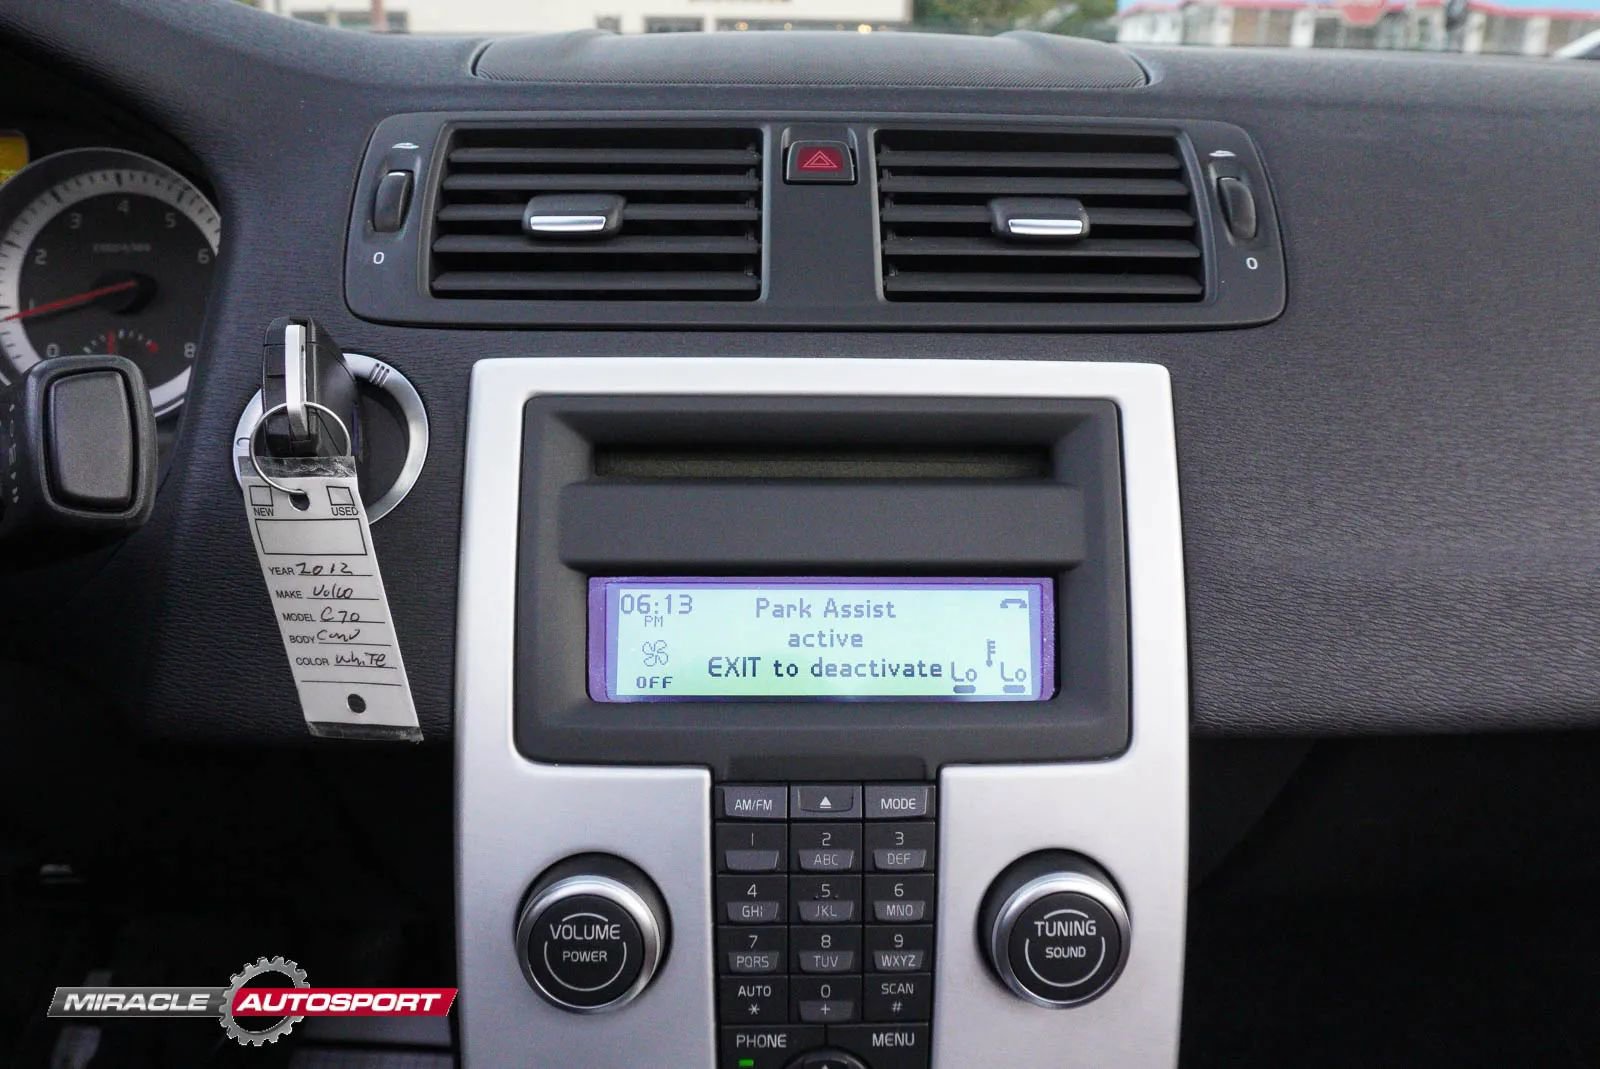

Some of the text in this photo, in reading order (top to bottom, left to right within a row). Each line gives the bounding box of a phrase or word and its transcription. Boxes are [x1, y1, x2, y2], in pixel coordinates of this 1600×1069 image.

[117, 200, 129, 214] 4
[70, 213, 82, 229] 3
[165, 212, 176, 228] 5
[34, 250, 47, 265] 2
[197, 250, 209, 264] 6
[47, 343, 59, 358] 0
[184, 342, 196, 357] 8
[253, 507, 274, 517] NEW
[331, 507, 359, 516] USED
[268, 567, 294, 576] YEAR
[295, 562, 353, 576] 2012
[276, 590, 303, 599] MAKE
[620, 593, 693, 615] 06:13
[755, 597, 897, 619] Park Assist
[282, 612, 316, 622] MODEL
[320, 606, 360, 624] C70
[644, 615, 664, 628] PM
[289, 634, 315, 644] BODY
[788, 629, 864, 648] active
[295, 656, 329, 666] COLOR
[708, 656, 943, 678] EXIT to deactivate
[636, 676, 674, 689] OFF
[734, 799, 773, 811] AM/FM
[881, 798, 916, 810] MODE
[821, 832, 832, 847] 2
[894, 831, 905, 846] 3
[813, 854, 839, 866] ABC
[887, 853, 912, 865] DEF
[747, 883, 758, 898] 4
[821, 883, 831, 898] 5
[894, 883, 904, 898] 6
[742, 905, 763, 918] GHI
[815, 905, 838, 917] JKL
[886, 904, 913, 917] MNO
[550, 923, 621, 940] VOLUME
[1034, 919, 1097, 937] TUNING
[748, 935, 758, 949] 7
[821, 934, 831, 948] 8
[893, 934, 904, 948] 9
[562, 950, 608, 962] POWER
[1045, 946, 1086, 958] SOUND
[736, 956, 769, 969] PQRS
[814, 955, 839, 968] TUV
[881, 954, 916, 968] WXYZ
[738, 985, 772, 997] AUTO
[820, 984, 831, 998] 0
[881, 983, 914, 995] SCAN
[736, 1034, 787, 1049] PHONE
[872, 1032, 916, 1047] MENU
